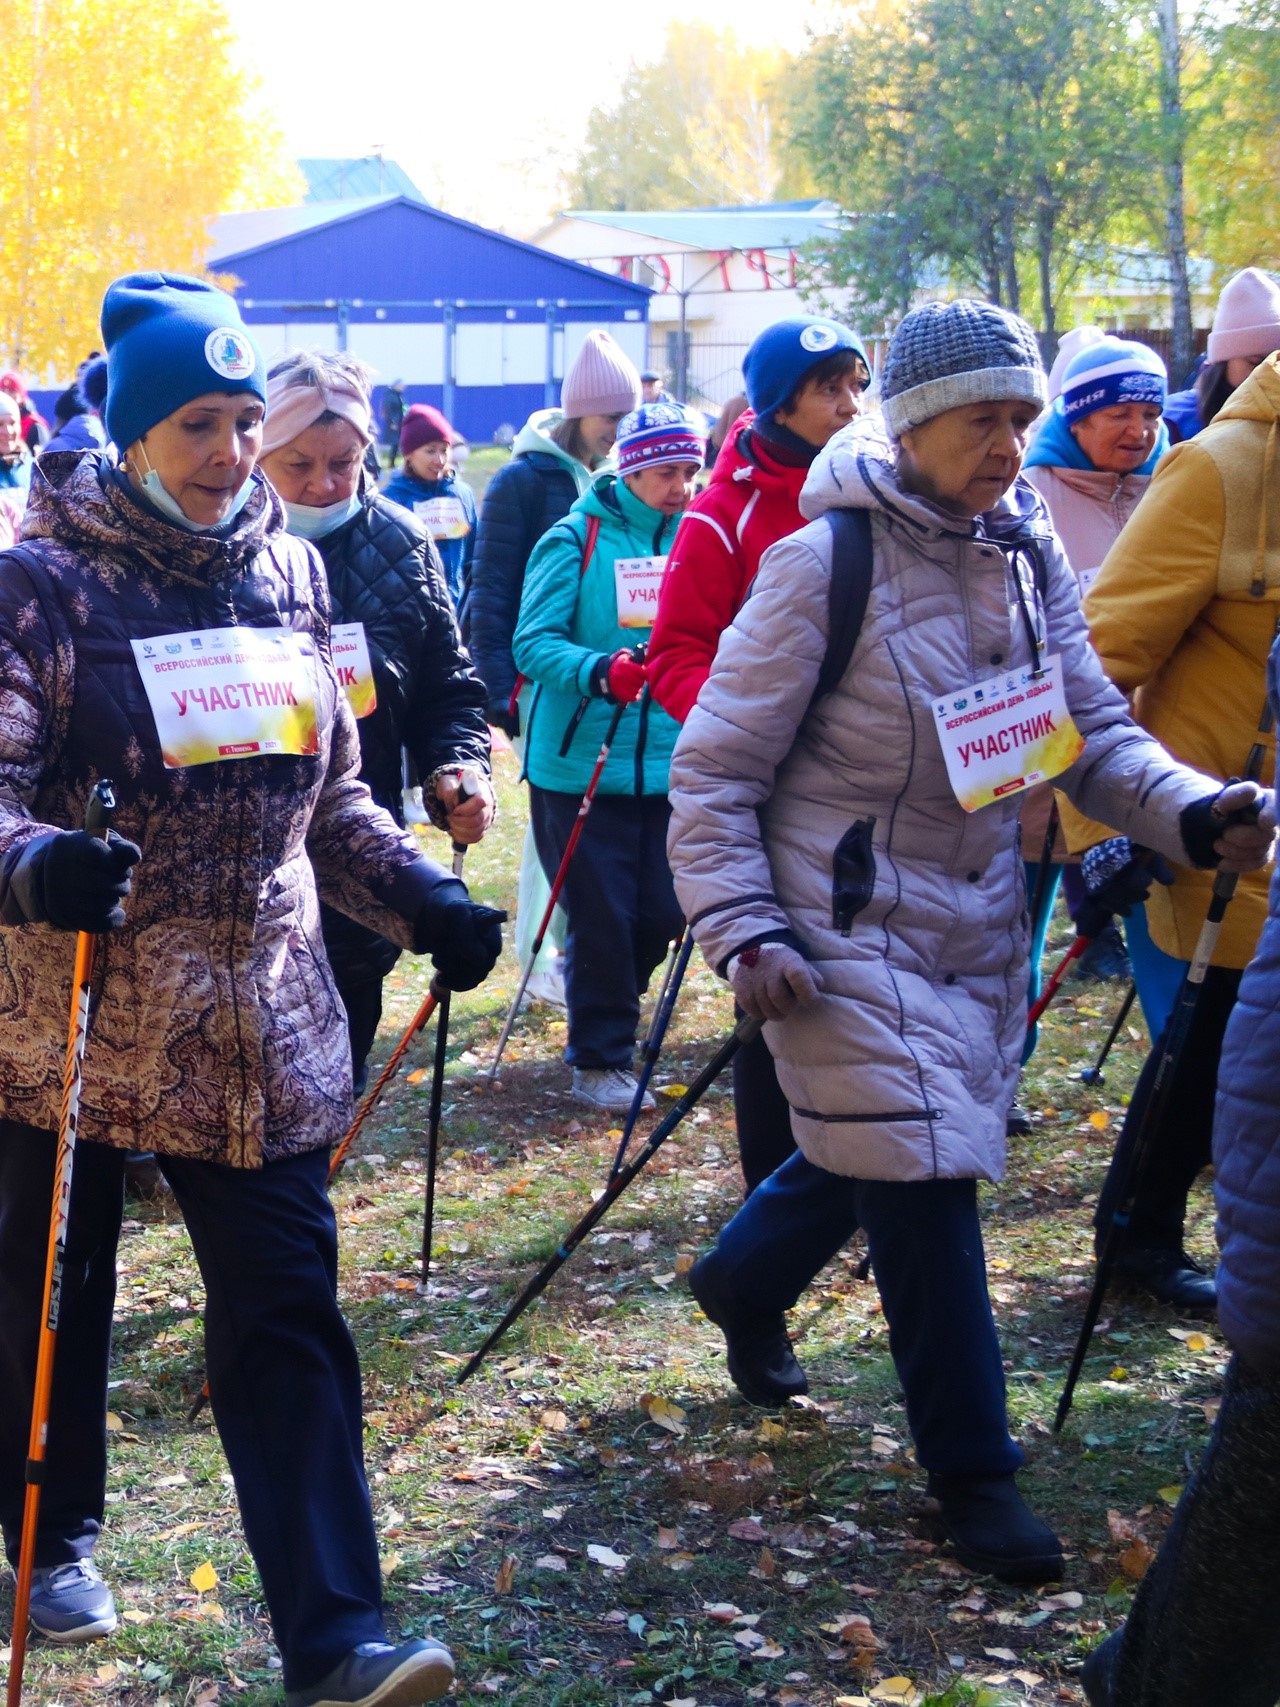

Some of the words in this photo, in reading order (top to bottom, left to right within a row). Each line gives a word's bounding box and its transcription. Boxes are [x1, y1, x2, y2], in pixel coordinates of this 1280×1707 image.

[154, 653, 233, 673] ВСЕРОССИЙСКИЙ
[171, 681, 298, 716] УЧАСТНИК
[945, 700, 1005, 730] ВСЕРОССИЙСКИЙ
[1007, 694, 1025, 709] ДЕНЬ
[1026, 682, 1053, 699] ХОДЬБЫ
[957, 710, 1057, 768] УЧАСТНИК
[47, 1244, 65, 1331] Larsen
